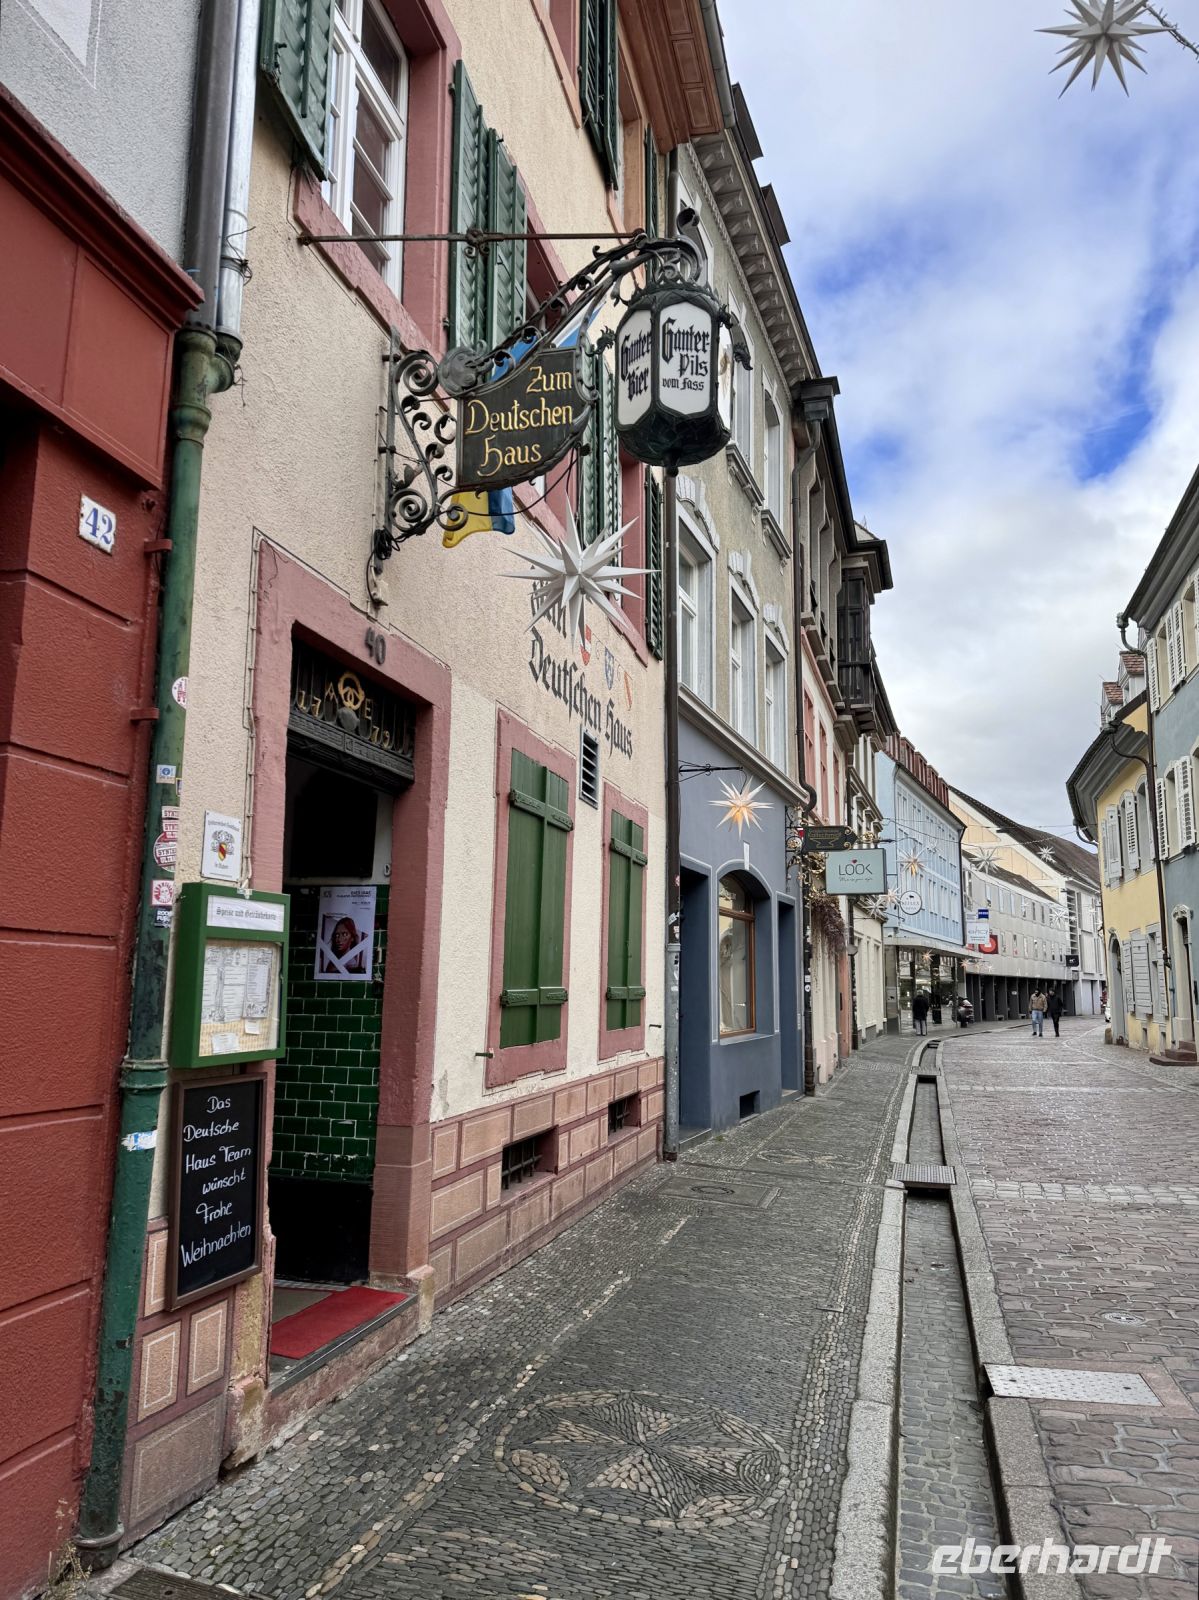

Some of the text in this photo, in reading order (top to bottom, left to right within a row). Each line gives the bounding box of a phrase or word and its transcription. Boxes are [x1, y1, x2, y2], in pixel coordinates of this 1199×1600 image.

[677, 353, 708, 377] Pils
[526, 366, 572, 393] Zum
[662, 378, 679, 389] vom
[465, 397, 573, 435] Deutschen
[477, 435, 542, 477] Haus
[85, 506, 112, 545] 42
[605, 699, 634, 761] Haus
[839, 863, 873, 876] LOOK
[206, 1095, 231, 1113] Das
[183, 1119, 240, 1142] Deutsche
[185, 1145, 252, 1174] Haus Team
[202, 1167, 246, 1195] wünscht
[196, 1201, 233, 1225] Frohe
[181, 1221, 252, 1267] Weihnachten
